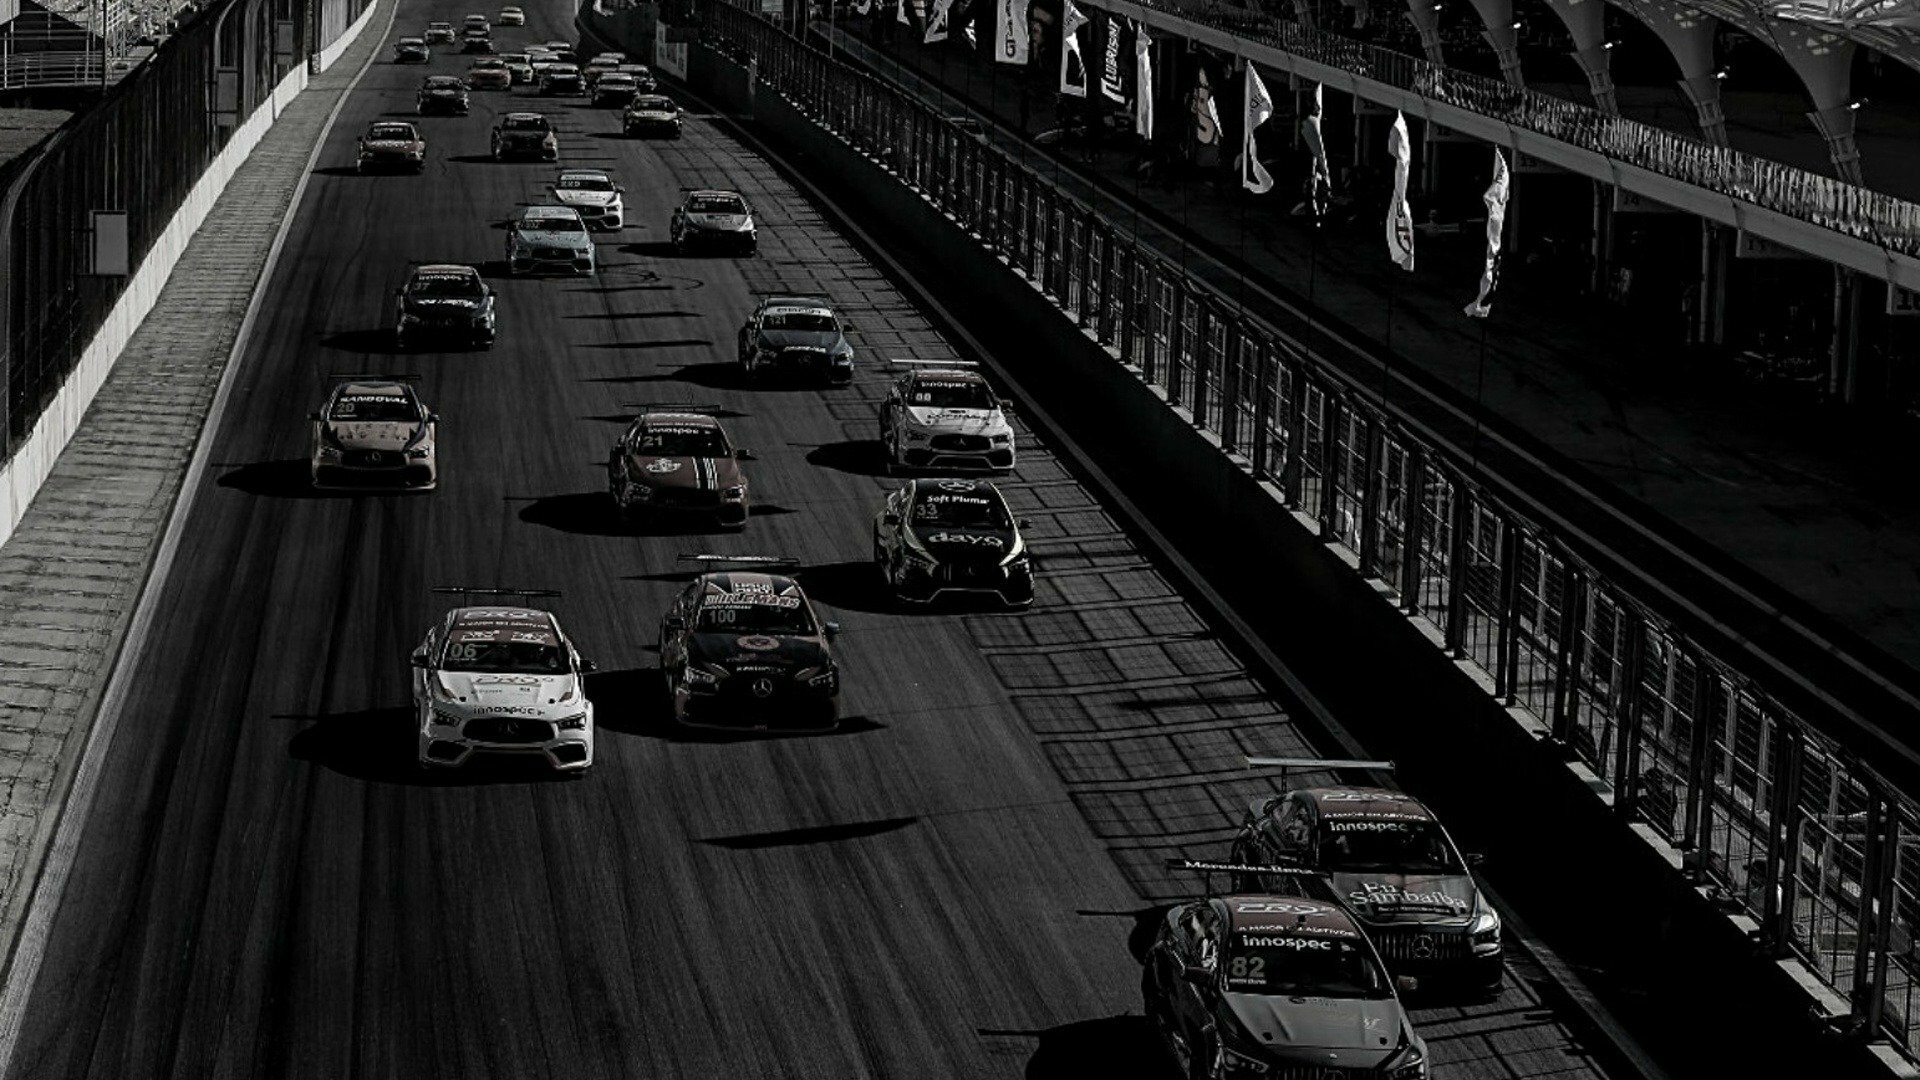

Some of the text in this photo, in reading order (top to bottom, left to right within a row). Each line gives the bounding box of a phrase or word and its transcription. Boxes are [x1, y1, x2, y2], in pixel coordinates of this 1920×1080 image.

[642, 435, 663, 448] 21
[916, 503, 938, 517] 33
[708, 608, 737, 623] 100
[450, 643, 478, 659] 06
[1328, 821, 1410, 834] innospec
[1241, 934, 1333, 952] innospec
[1230, 956, 1266, 978] 82
